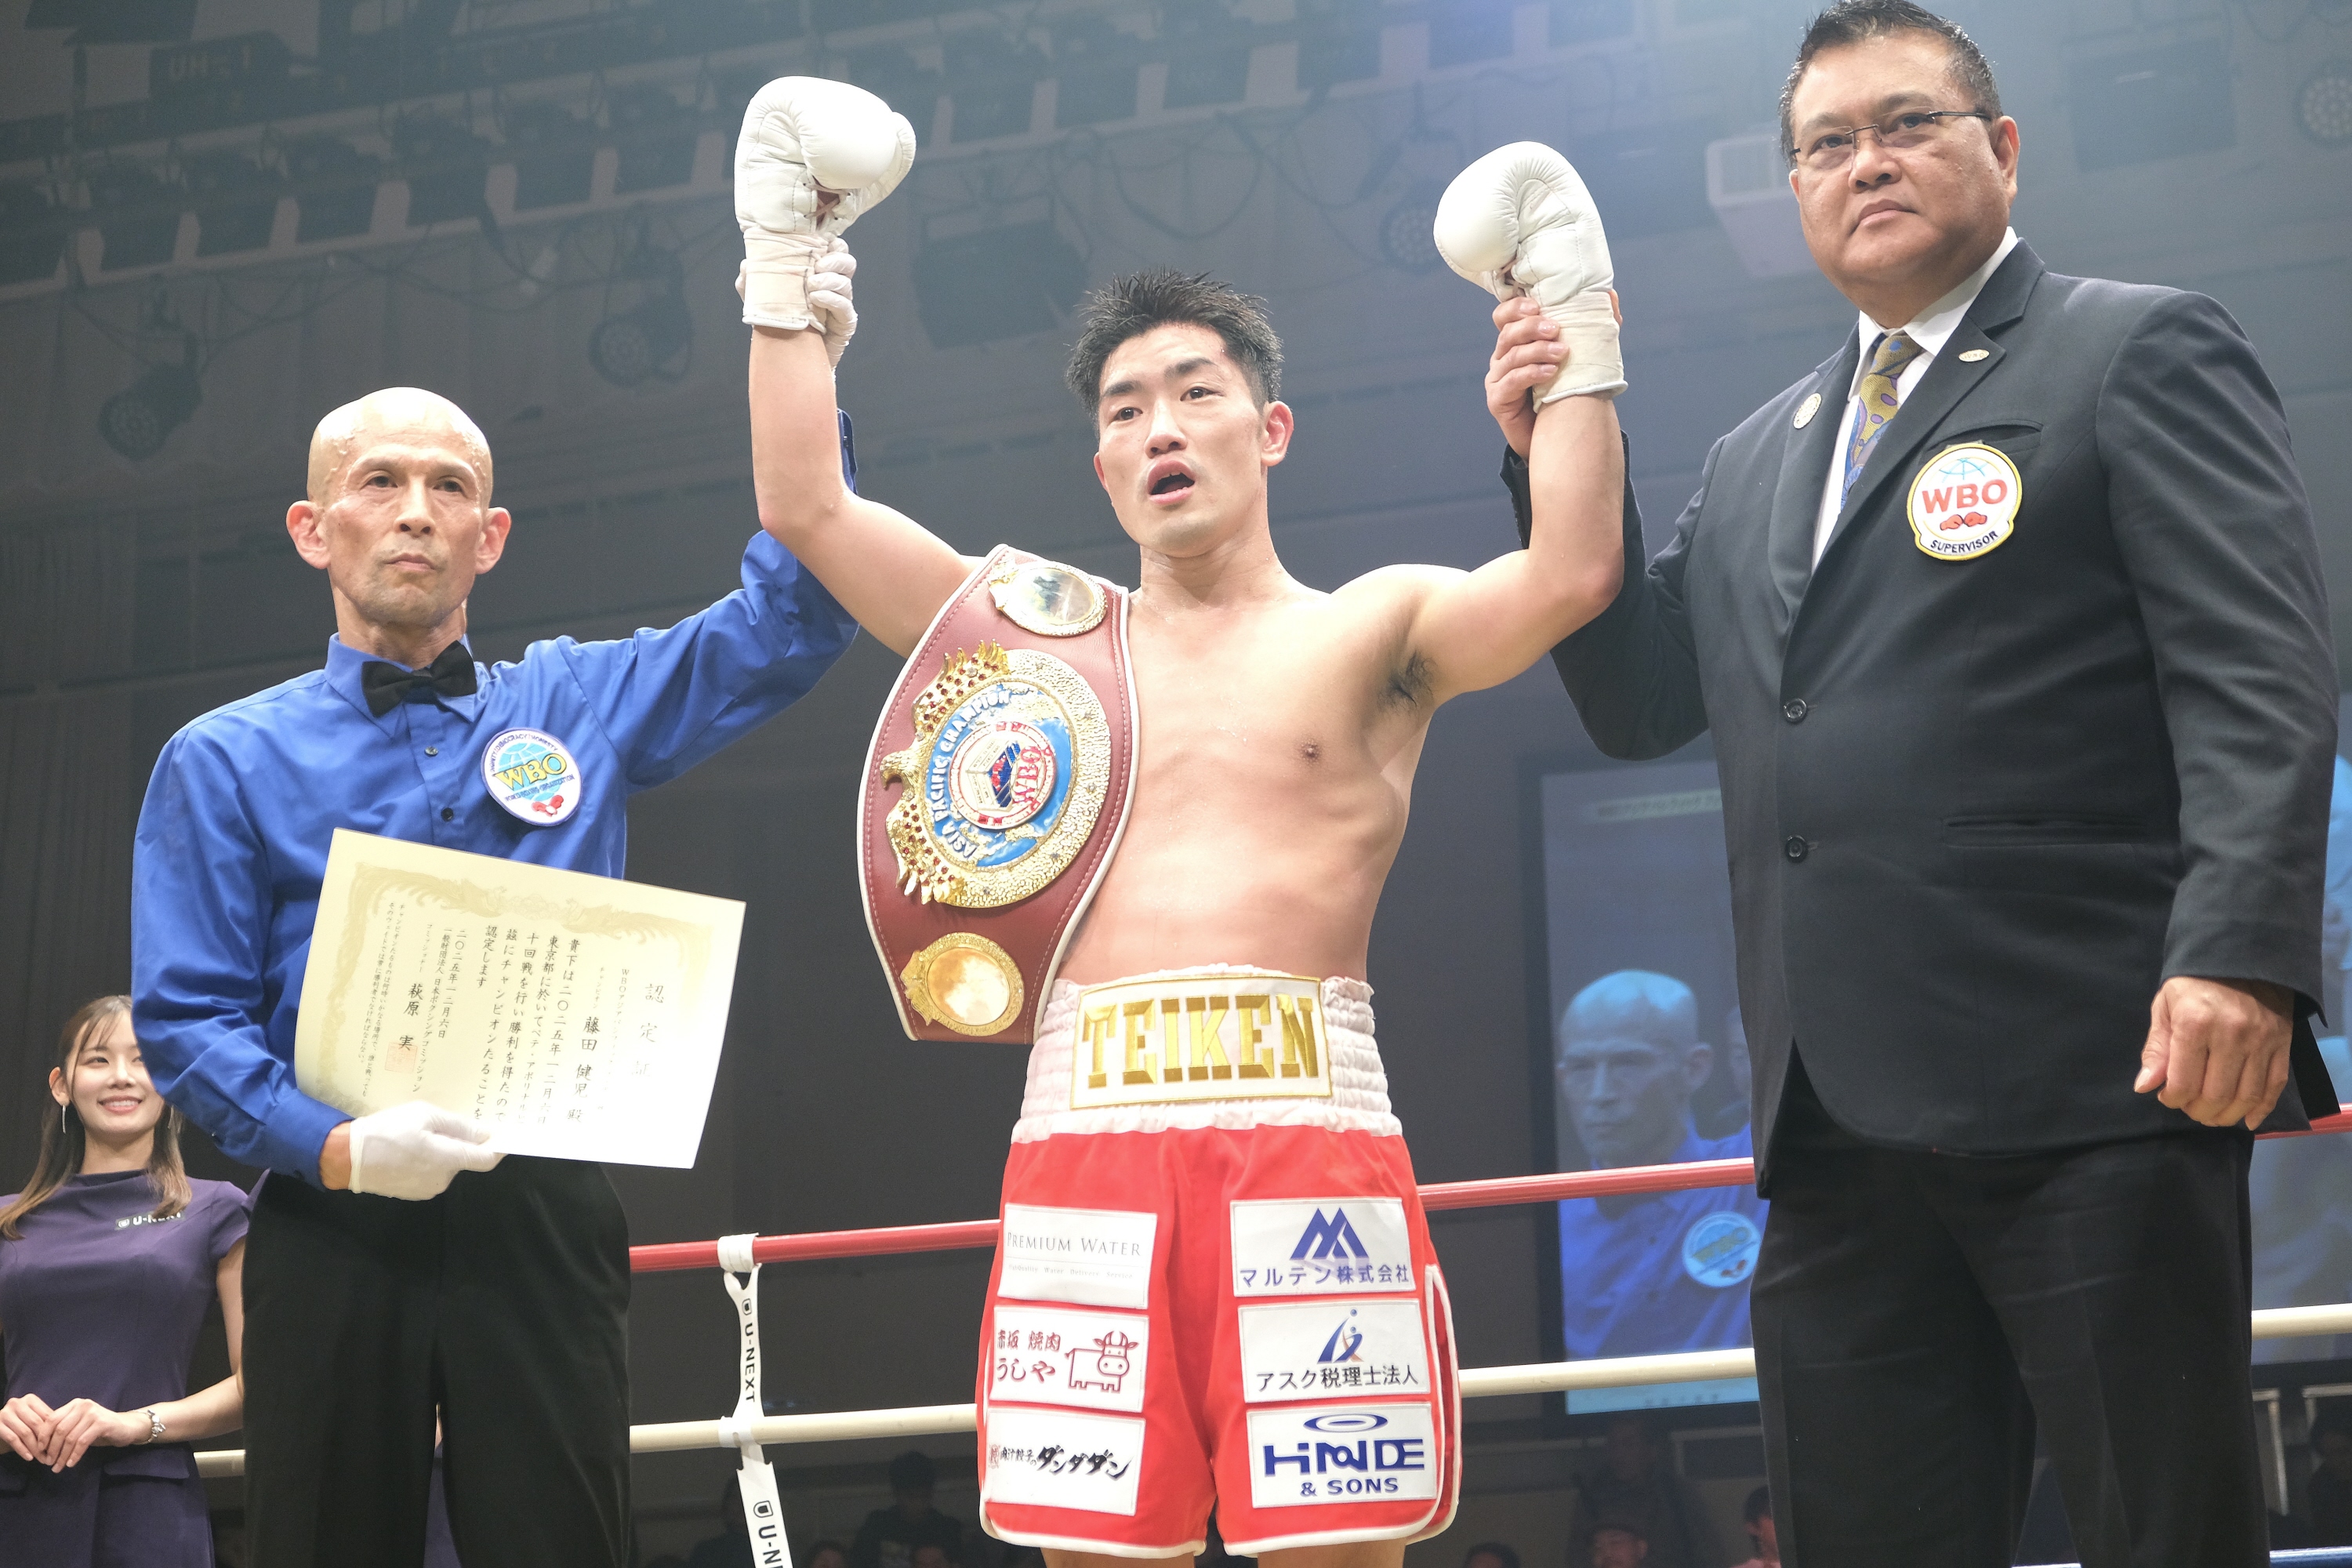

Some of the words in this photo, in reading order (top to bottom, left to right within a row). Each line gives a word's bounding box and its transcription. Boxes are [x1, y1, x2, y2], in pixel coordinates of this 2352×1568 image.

[1922, 479, 2008, 514] WBO
[1930, 531, 1998, 554] SUPERVISOR
[492, 753, 567, 791] WBO
[931, 755, 952, 822] PACIFIC
[1011, 746, 1042, 805] WBO
[942, 820, 978, 858] ASIA
[419, 924, 433, 973] コミッショナー
[435, 928, 452, 975] 一般財団法人
[477, 925, 497, 989] 認定します
[397, 1035, 414, 1051] 実
[582, 1016, 601, 1051] 藤田
[1082, 993, 1319, 1089] TEIKEN
[573, 1064, 593, 1098] 健児
[1007, 1232, 1071, 1252] PREMIUM
[1081, 1236, 1141, 1256] WATER
[1240, 1264, 1410, 1287] マルテン株式会社
[996, 1329, 1019, 1350] 赤坂
[1028, 1330, 1061, 1352] 焼肉
[744, 1322, 755, 1403] U-NEXT
[996, 1357, 1055, 1384] うしや
[1256, 1364, 1419, 1392] アスク税理士法人
[1300, 1482, 1318, 1497] &
[1327, 1477, 1399, 1497] SONS
